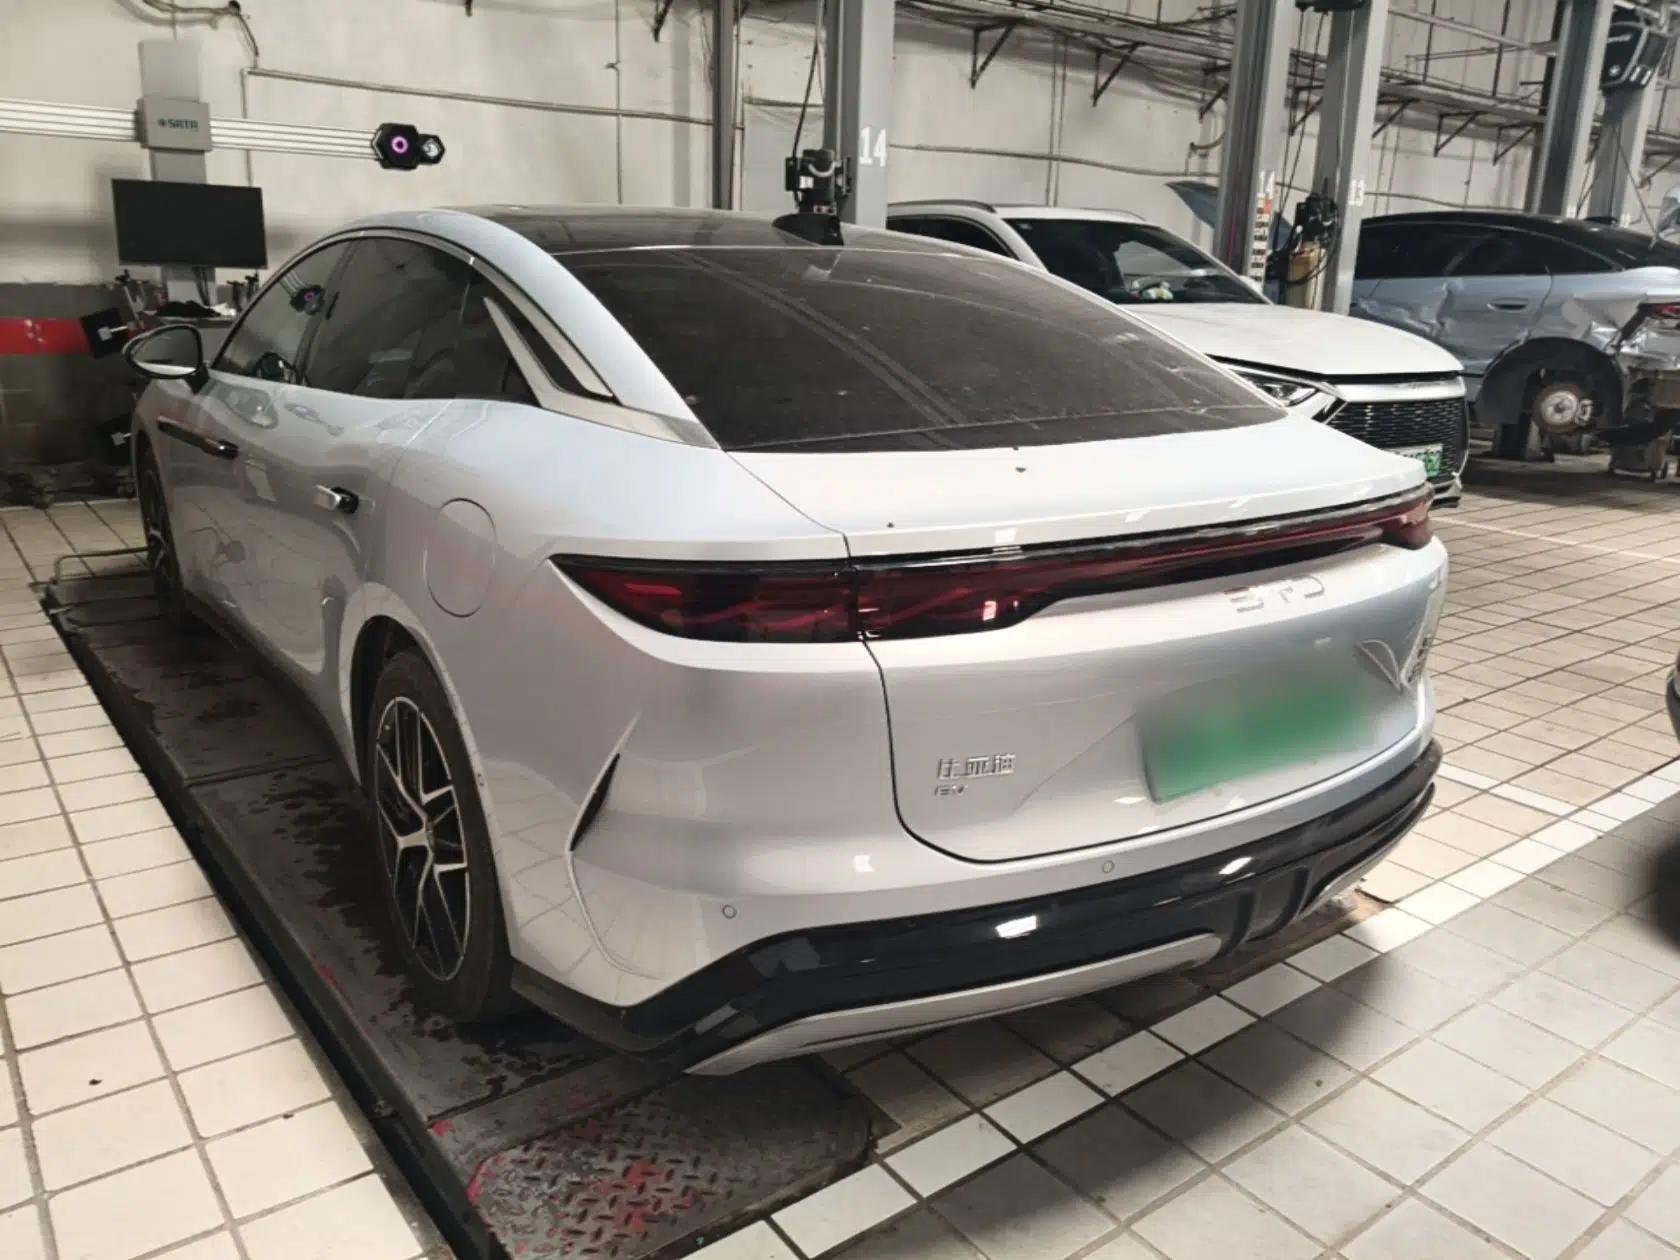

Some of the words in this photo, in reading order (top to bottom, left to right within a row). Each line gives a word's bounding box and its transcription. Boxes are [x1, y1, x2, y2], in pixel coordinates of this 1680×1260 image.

[860, 127, 887, 167] 14
[1258, 170, 1275, 199] 14
[936, 753, 1016, 780] 比亚迪
